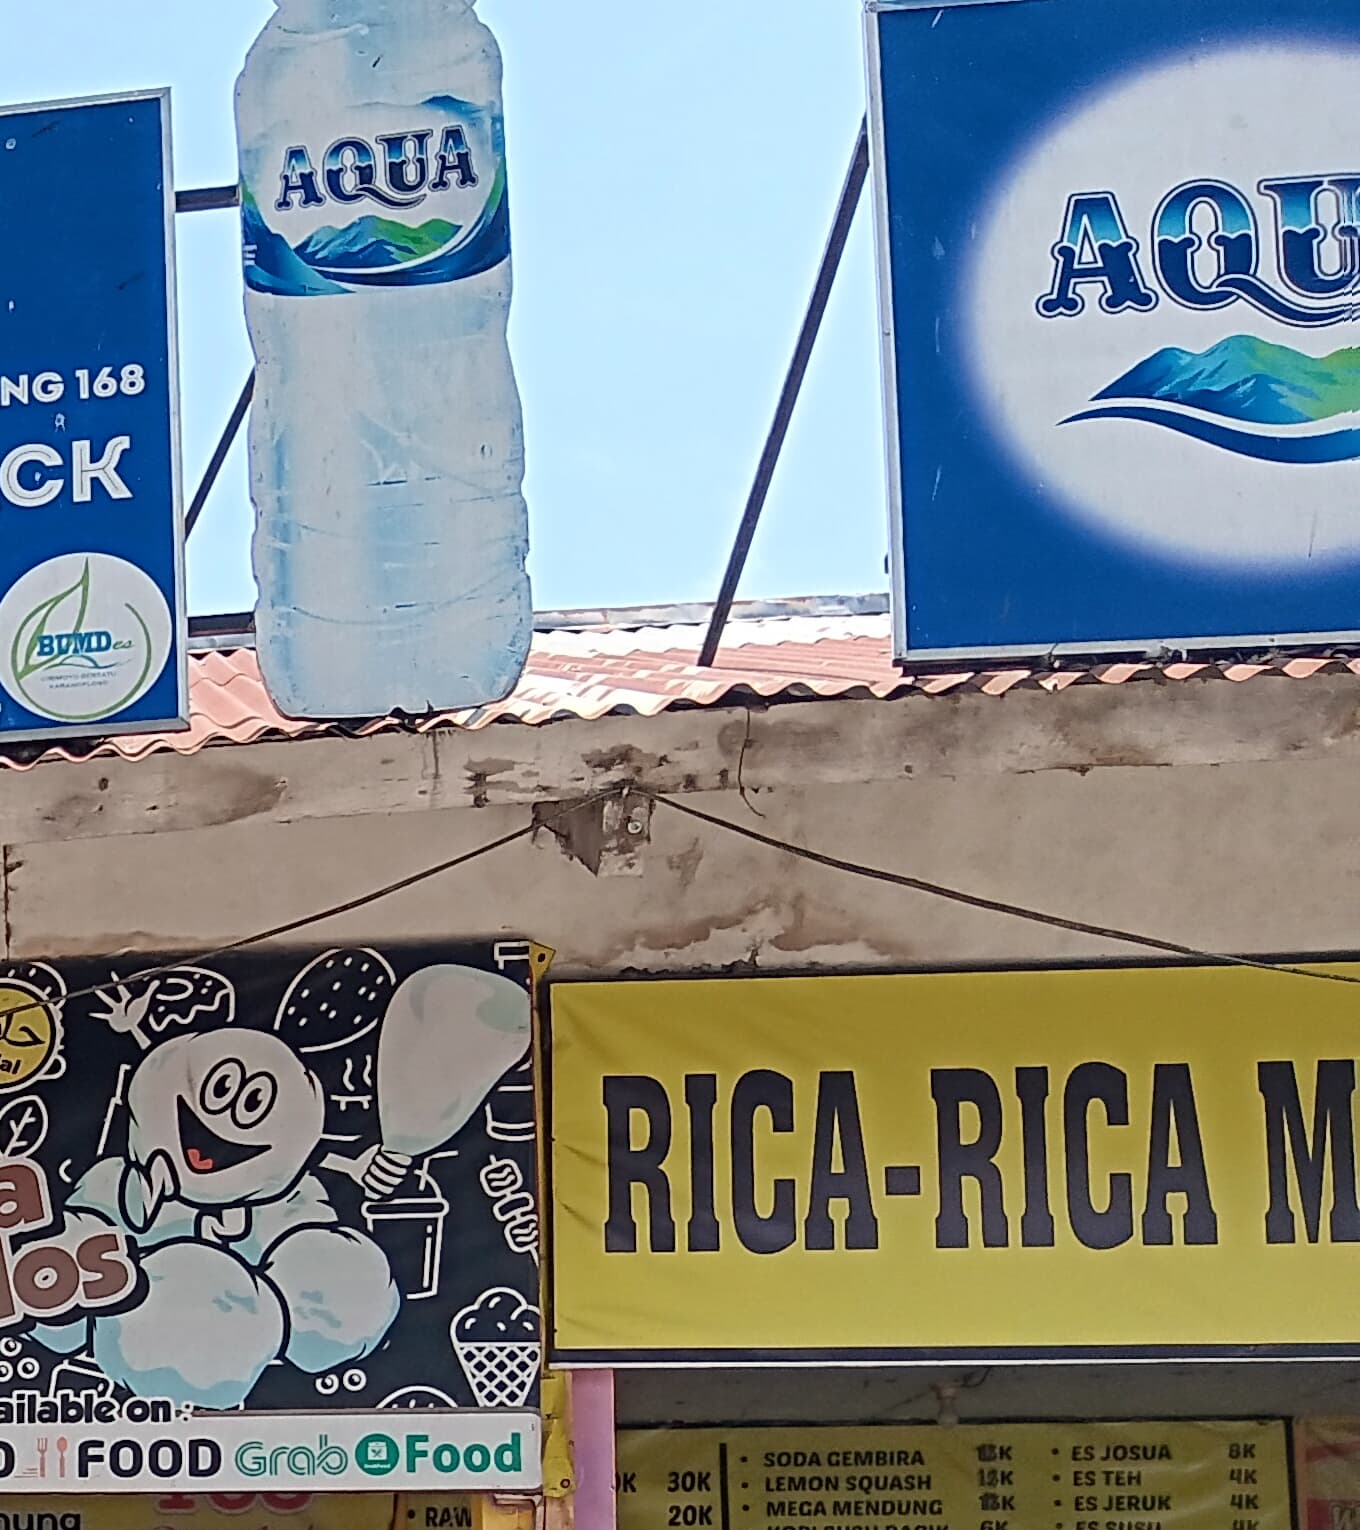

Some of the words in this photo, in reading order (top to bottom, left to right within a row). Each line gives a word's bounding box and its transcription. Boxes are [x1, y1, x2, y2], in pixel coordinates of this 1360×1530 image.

[274, 125, 478, 212] AQUA
[1035, 172, 1360, 328] AQU
[75, 363, 146, 398] 168
[601, 1060, 1219, 1255] RICA-RICA
[79, 1438, 221, 1479] FOOD
[235, 1433, 349, 1477] Grab
[406, 1432, 521, 1474] Food
[763, 1452, 827, 1468] SODA
[829, 1451, 925, 1467] GEMBIRA
[1072, 1446, 1094, 1461] ES
[1100, 1445, 1172, 1461] JOSUA
[1229, 1443, 1256, 1459] 8K
[667, 1472, 711, 1492] 30K
[765, 1476, 839, 1492] LEMON
[846, 1475, 931, 1494] SQUASH
[1073, 1471, 1096, 1486] ES
[1103, 1471, 1142, 1486] TEH
[766, 1500, 827, 1517] MEGA
[832, 1500, 943, 1516] MENDUNG
[1074, 1496, 1097, 1511] ES
[1103, 1495, 1171, 1511] JERUK
[668, 1506, 712, 1527] 20K
